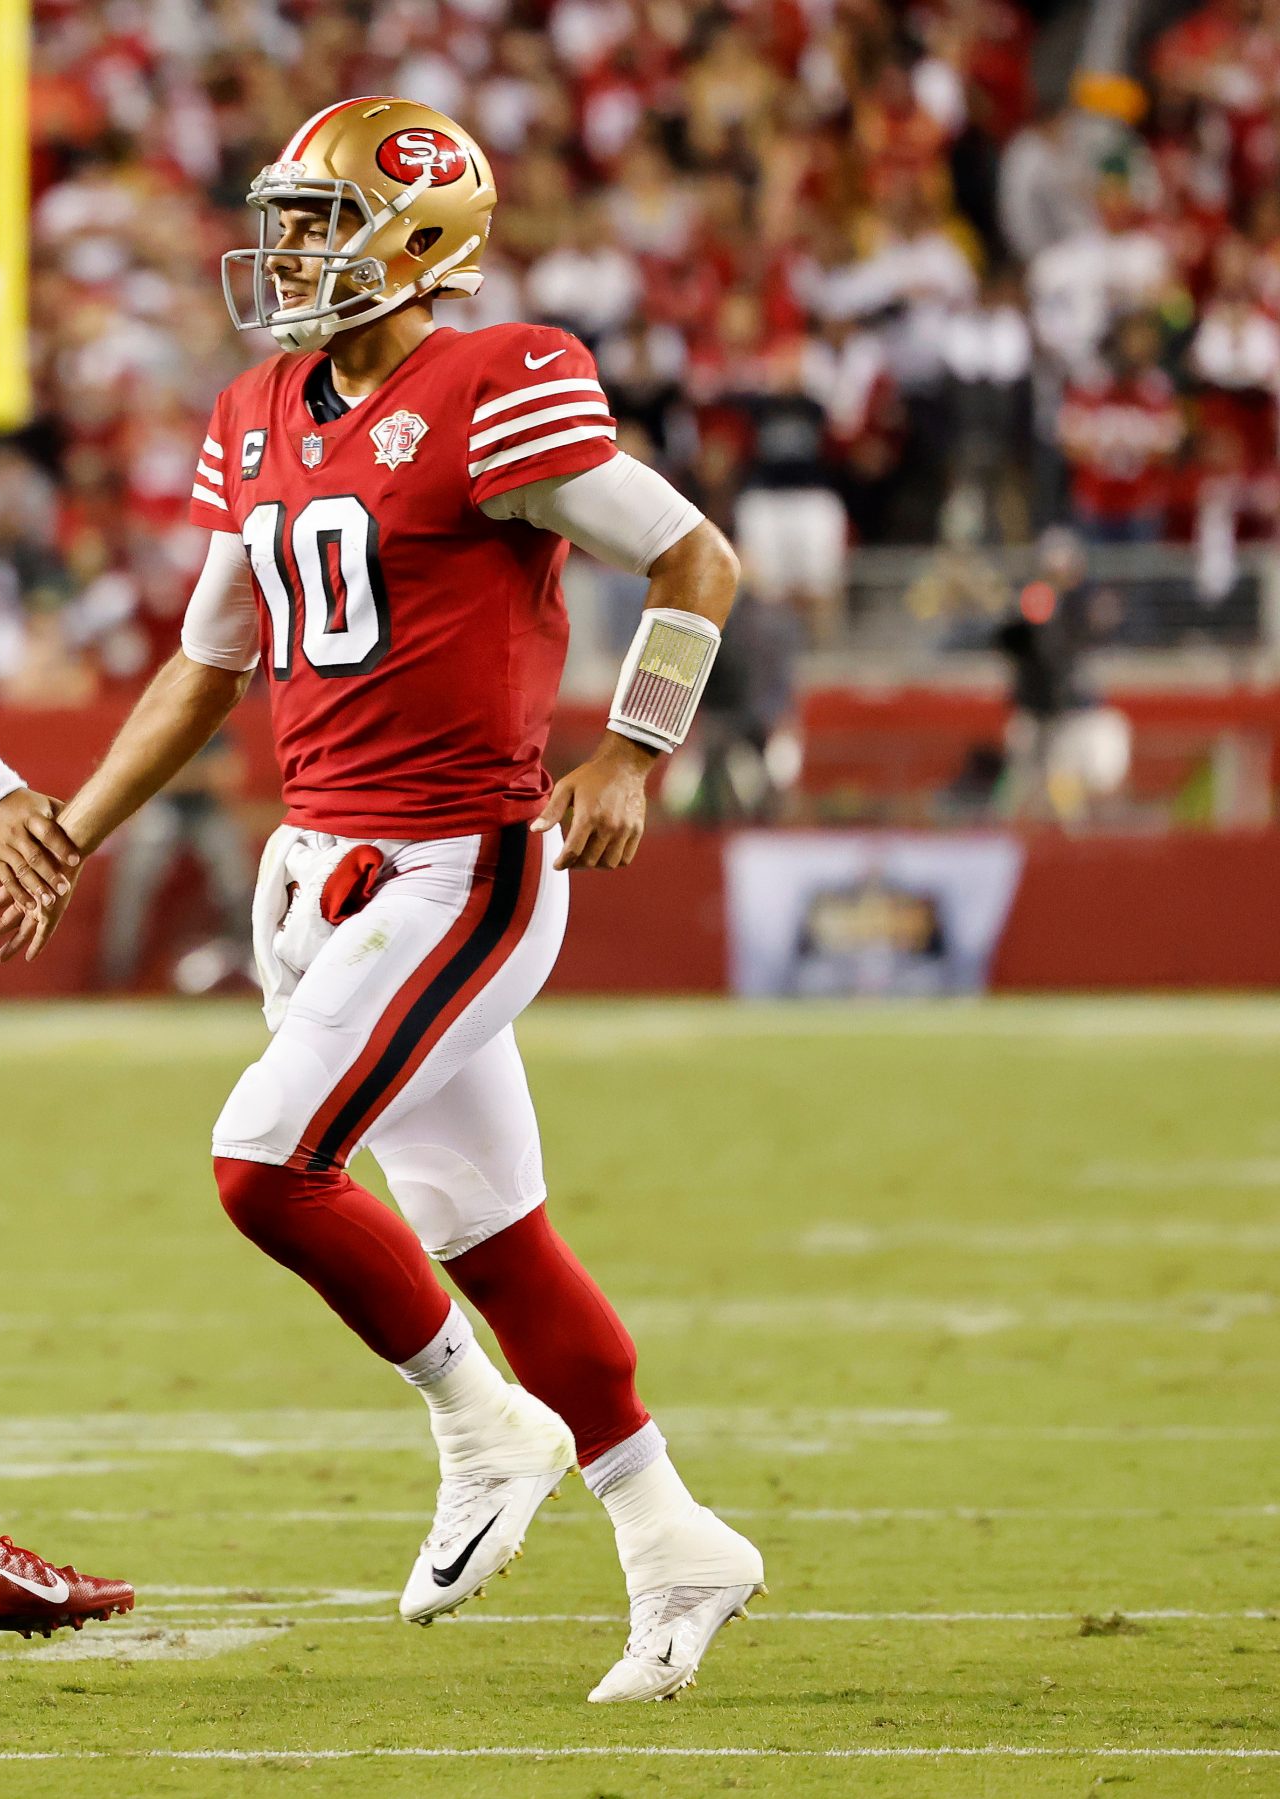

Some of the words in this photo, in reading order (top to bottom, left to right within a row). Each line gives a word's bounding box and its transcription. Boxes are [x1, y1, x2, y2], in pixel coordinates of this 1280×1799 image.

[241, 430, 266, 468] C
[383, 422, 414, 451] 75
[242, 494, 391, 680] 10
